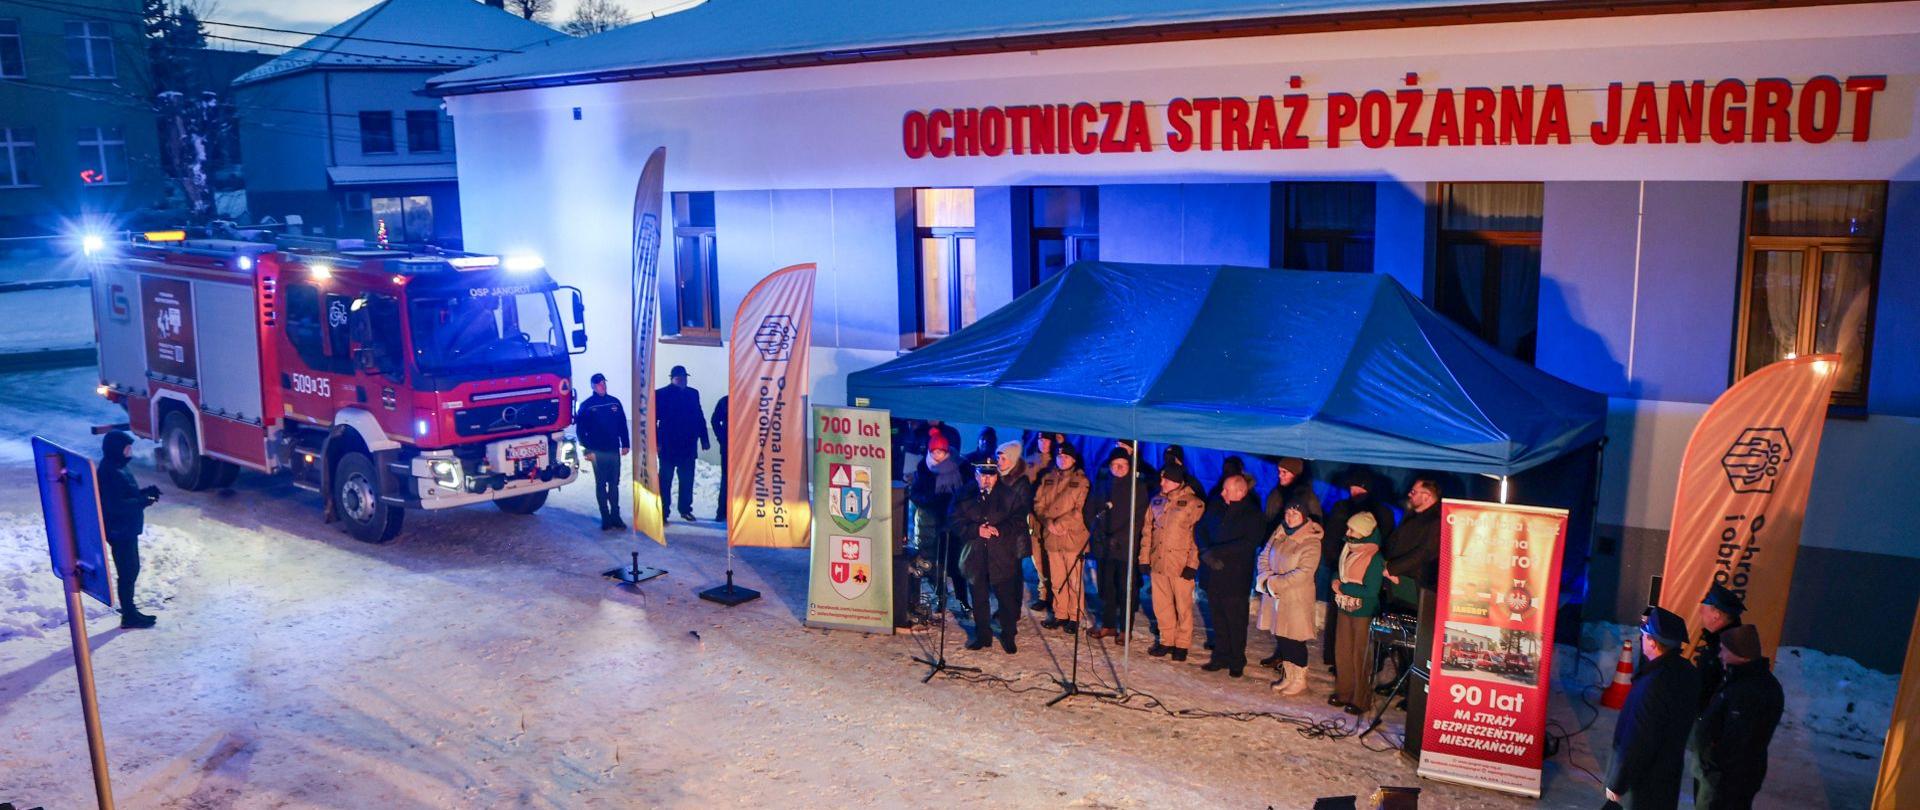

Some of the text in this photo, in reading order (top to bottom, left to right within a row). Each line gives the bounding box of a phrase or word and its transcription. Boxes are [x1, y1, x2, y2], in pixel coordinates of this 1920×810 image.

[903, 72, 1887, 159] OCHOTNICZA STRAŻ POŻARNA JANGROT
[470, 287, 489, 297] OSP
[758, 385, 773, 448] obrona
[821, 415, 880, 437] 700 lat
[816, 437, 886, 460] Jangrota
[772, 458, 788, 528] ludności
[1713, 527, 1741, 586] obro
[1733, 514, 1765, 601] Ochron
[1450, 683, 1524, 713] 90 lat
[1433, 719, 1534, 745] BEZPIECZEŃSTWA
[1453, 709, 1517, 727] NA STRAŻY
[1439, 733, 1526, 757] MIESZKAŃCÓW
